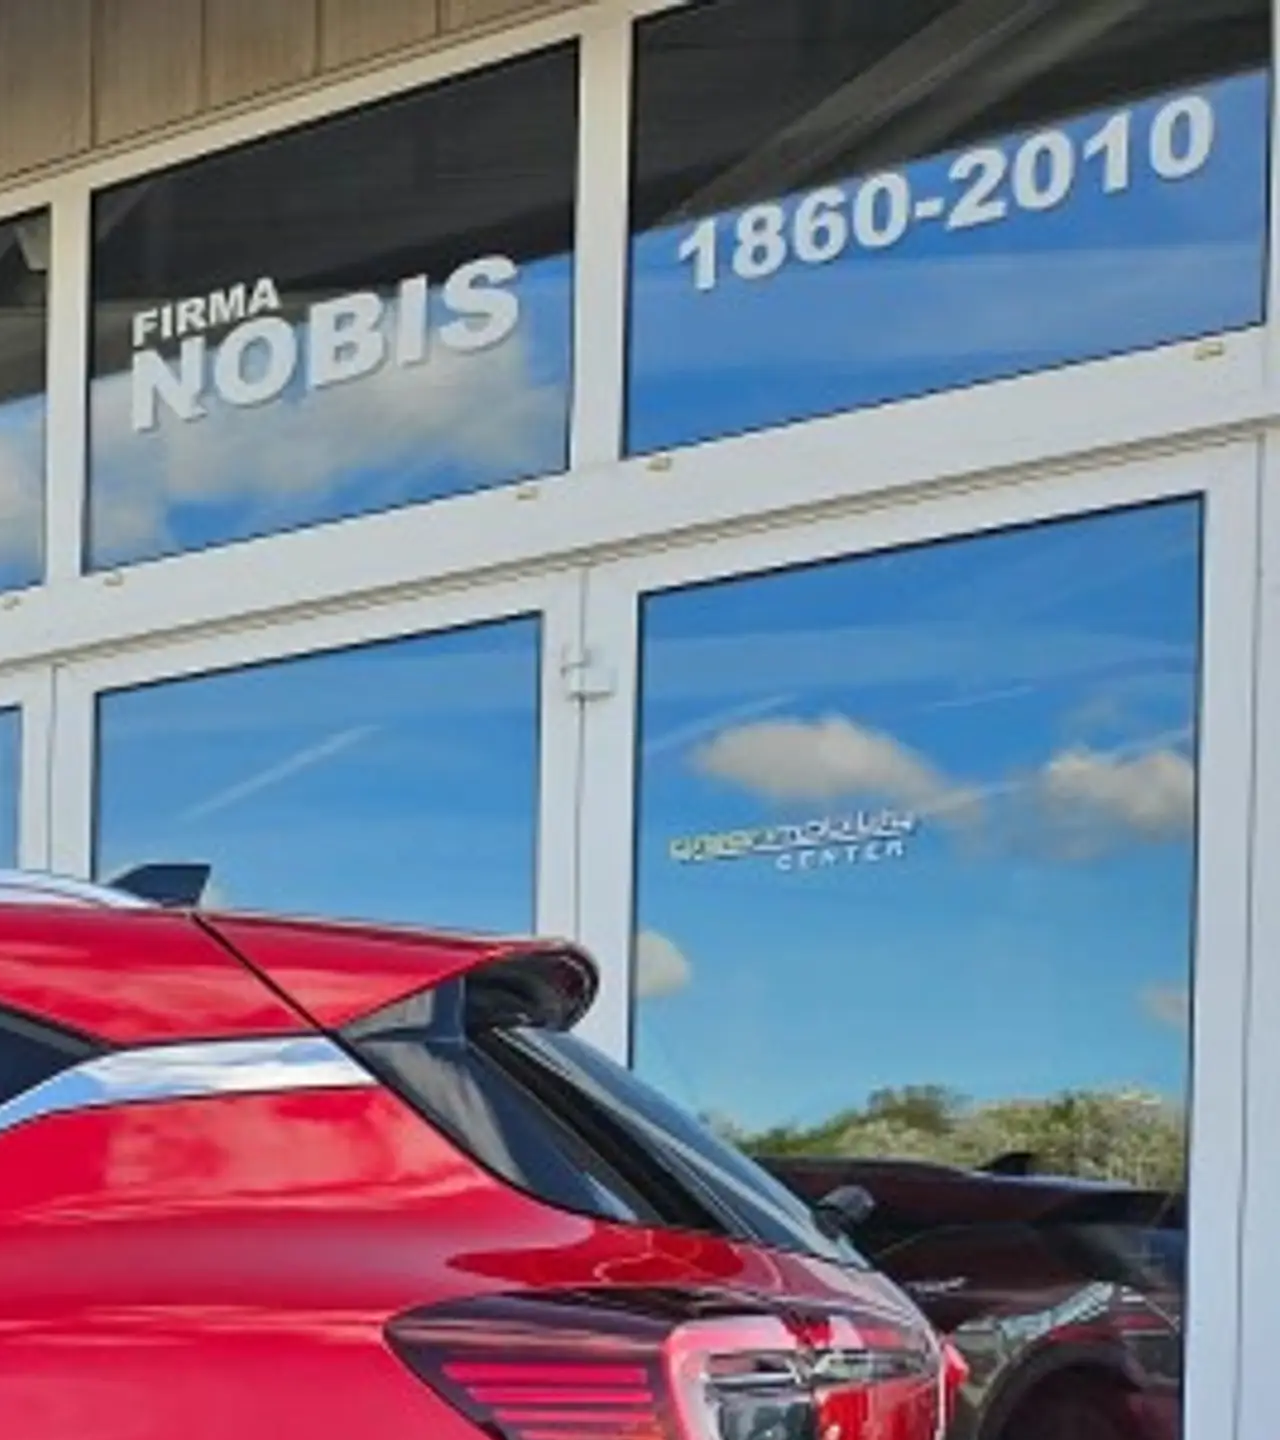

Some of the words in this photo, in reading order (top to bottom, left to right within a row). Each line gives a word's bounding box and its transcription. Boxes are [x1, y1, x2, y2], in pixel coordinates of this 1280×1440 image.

[678, 96, 1214, 290] 1860-2010
[131, 277, 281, 347] FIRMA
[131, 255, 520, 431] NOBIS
